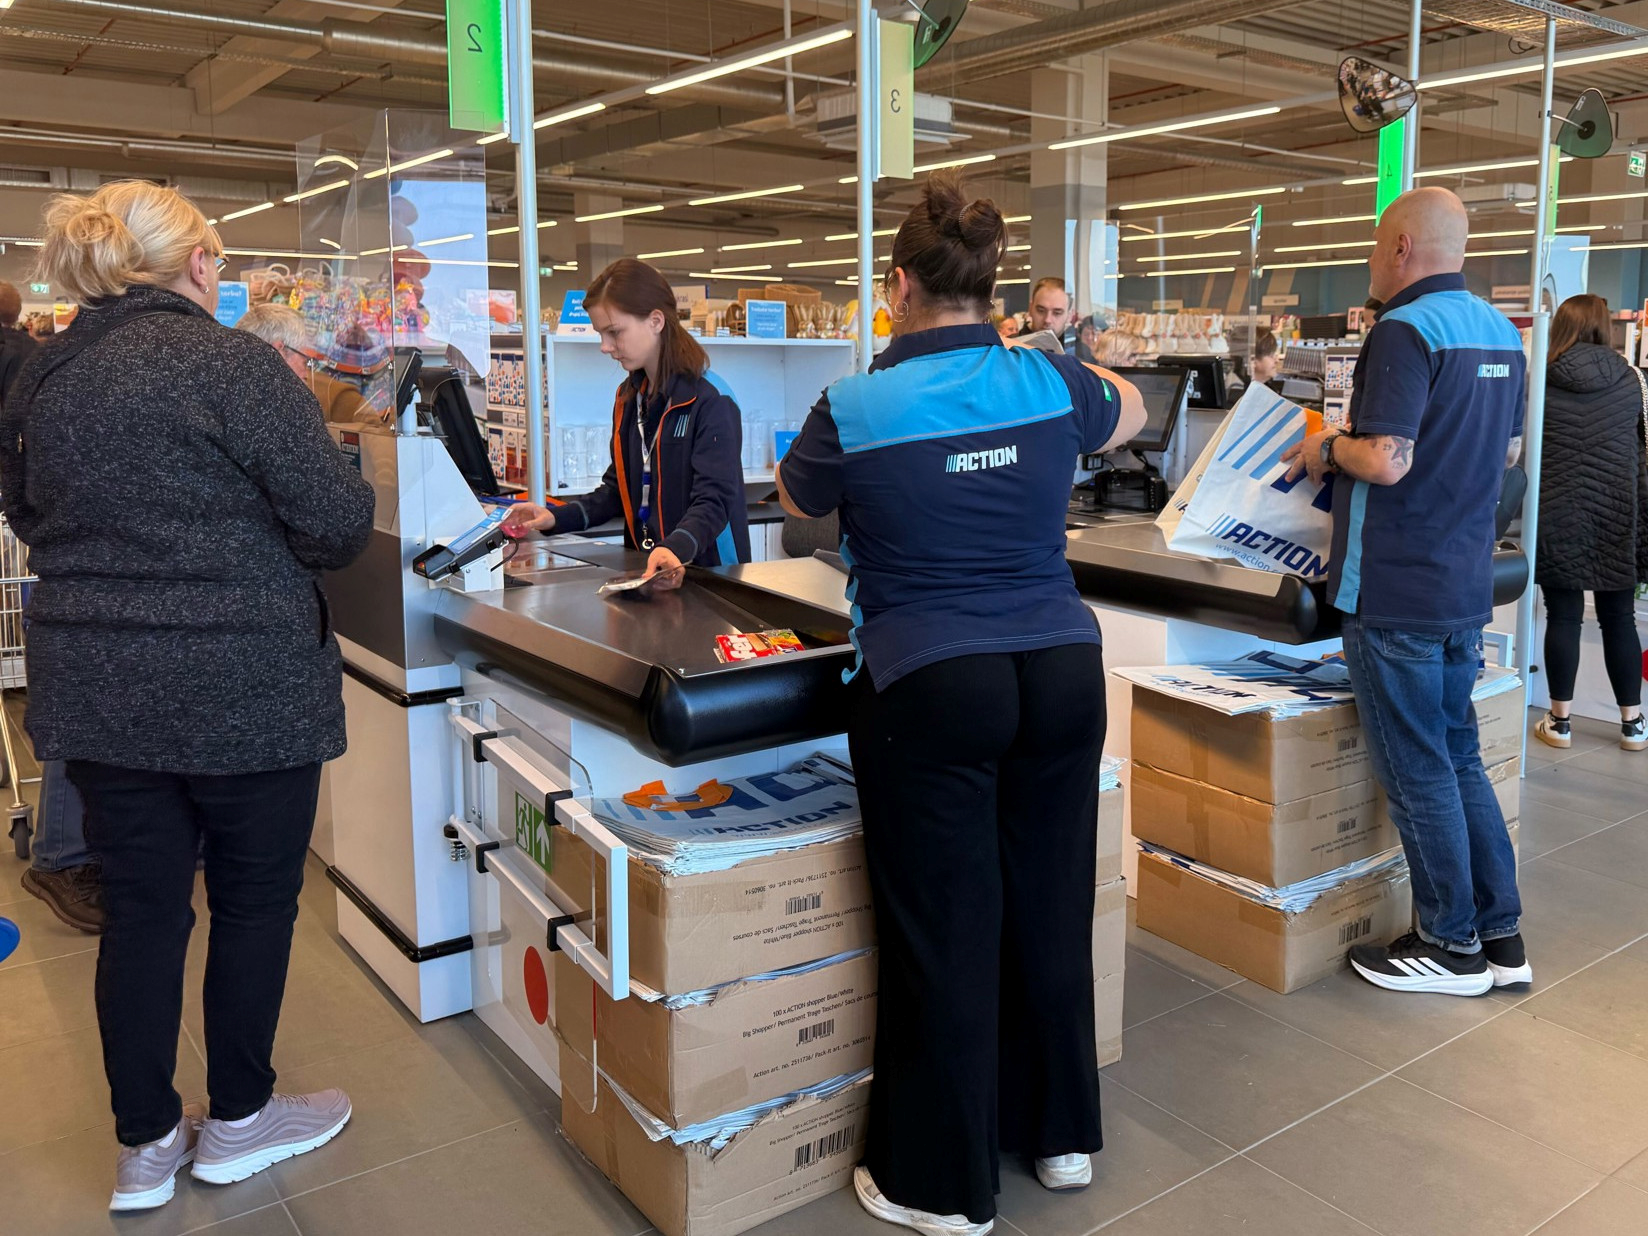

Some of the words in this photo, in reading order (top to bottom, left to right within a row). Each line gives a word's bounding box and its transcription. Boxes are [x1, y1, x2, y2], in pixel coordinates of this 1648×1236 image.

[1481, 363, 1510, 378] ACTION
[955, 445, 1018, 473] ACTION
[1221, 522, 1330, 576] ACTION
[1215, 543, 1281, 574] www.action
[713, 800, 853, 835] ACTION
[745, 886, 766, 896] 3060514
[775, 921, 798, 932] Taschen/
[798, 917, 812, 926] Trage
[813, 924, 832, 934] ACTION
[732, 933, 754, 942] courses
[763, 927, 774, 935] Sacs
[793, 928, 813, 937] shopper
[773, 1009, 782, 1018] 100
[787, 1002, 806, 1013] ACTION
[806, 995, 827, 1008] shopper
[827, 988, 854, 1002] Blue/White
[742, 1030, 751, 1038] Big
[752, 1022, 777, 1035] Shopper/
[778, 1013, 806, 1027] Permanent
[807, 1009, 821, 1018] Trage
[822, 1001, 844, 1013] Taschen/
[844, 998, 856, 1006] Sacs
[753, 1069, 770, 1079] Action
[771, 1065, 780, 1073] art.
[791, 1053, 814, 1066] 2511736/
[832, 1045, 842, 1053] art.
